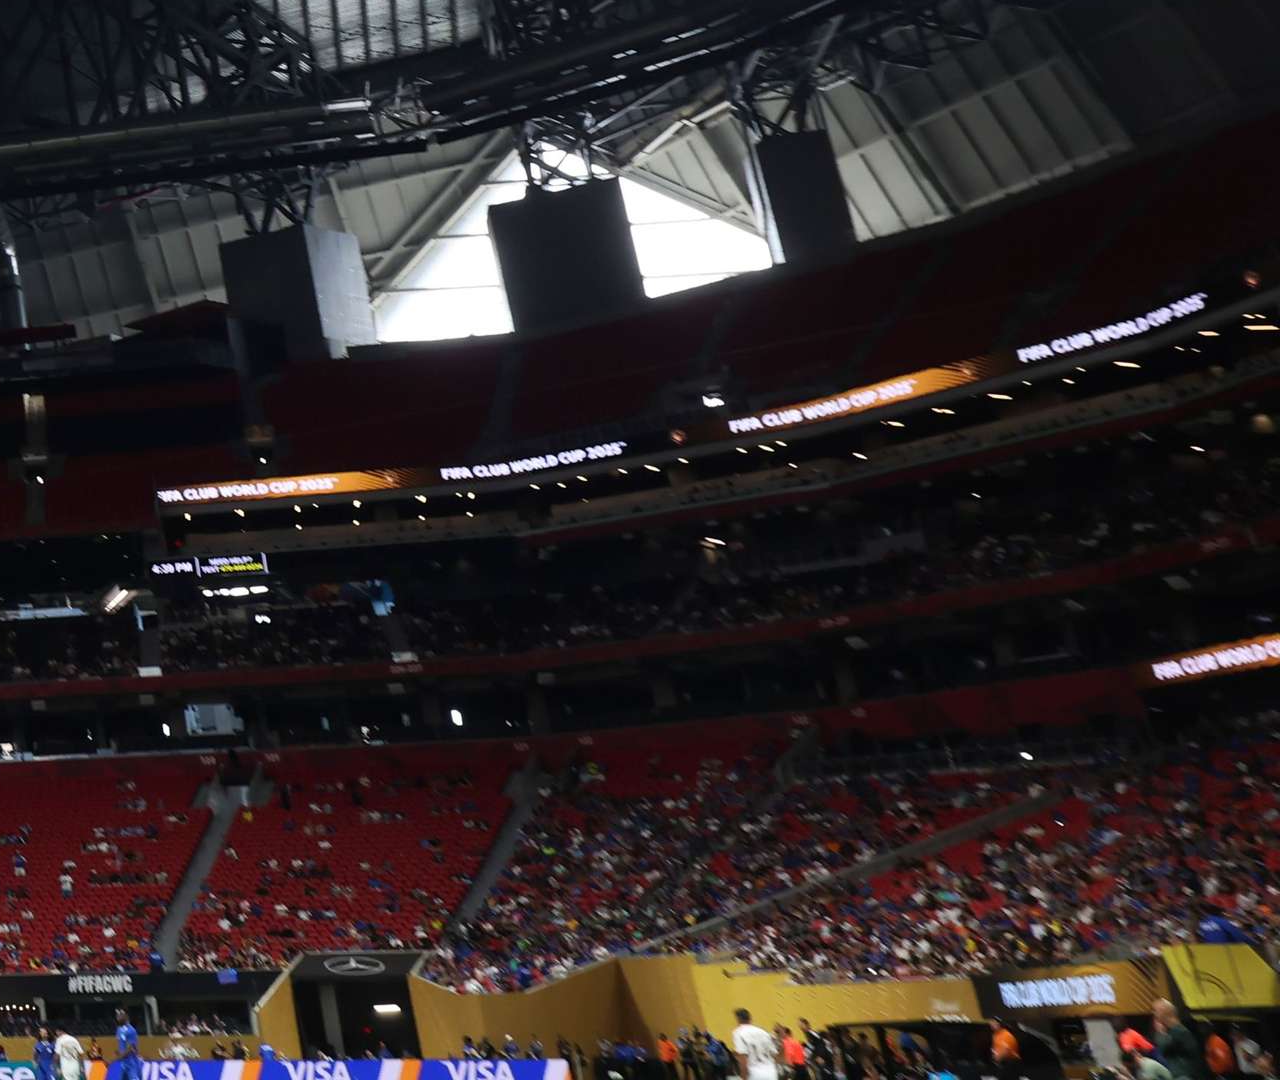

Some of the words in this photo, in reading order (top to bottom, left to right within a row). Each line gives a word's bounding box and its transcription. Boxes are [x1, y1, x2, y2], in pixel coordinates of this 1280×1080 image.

[440, 466, 473, 480] FIFA
[472, 463, 511, 478] CLUB
[183, 487, 219, 500] CLUB
[279, 1060, 351, 1080] VISA
[439, 1060, 515, 1080] VISA
